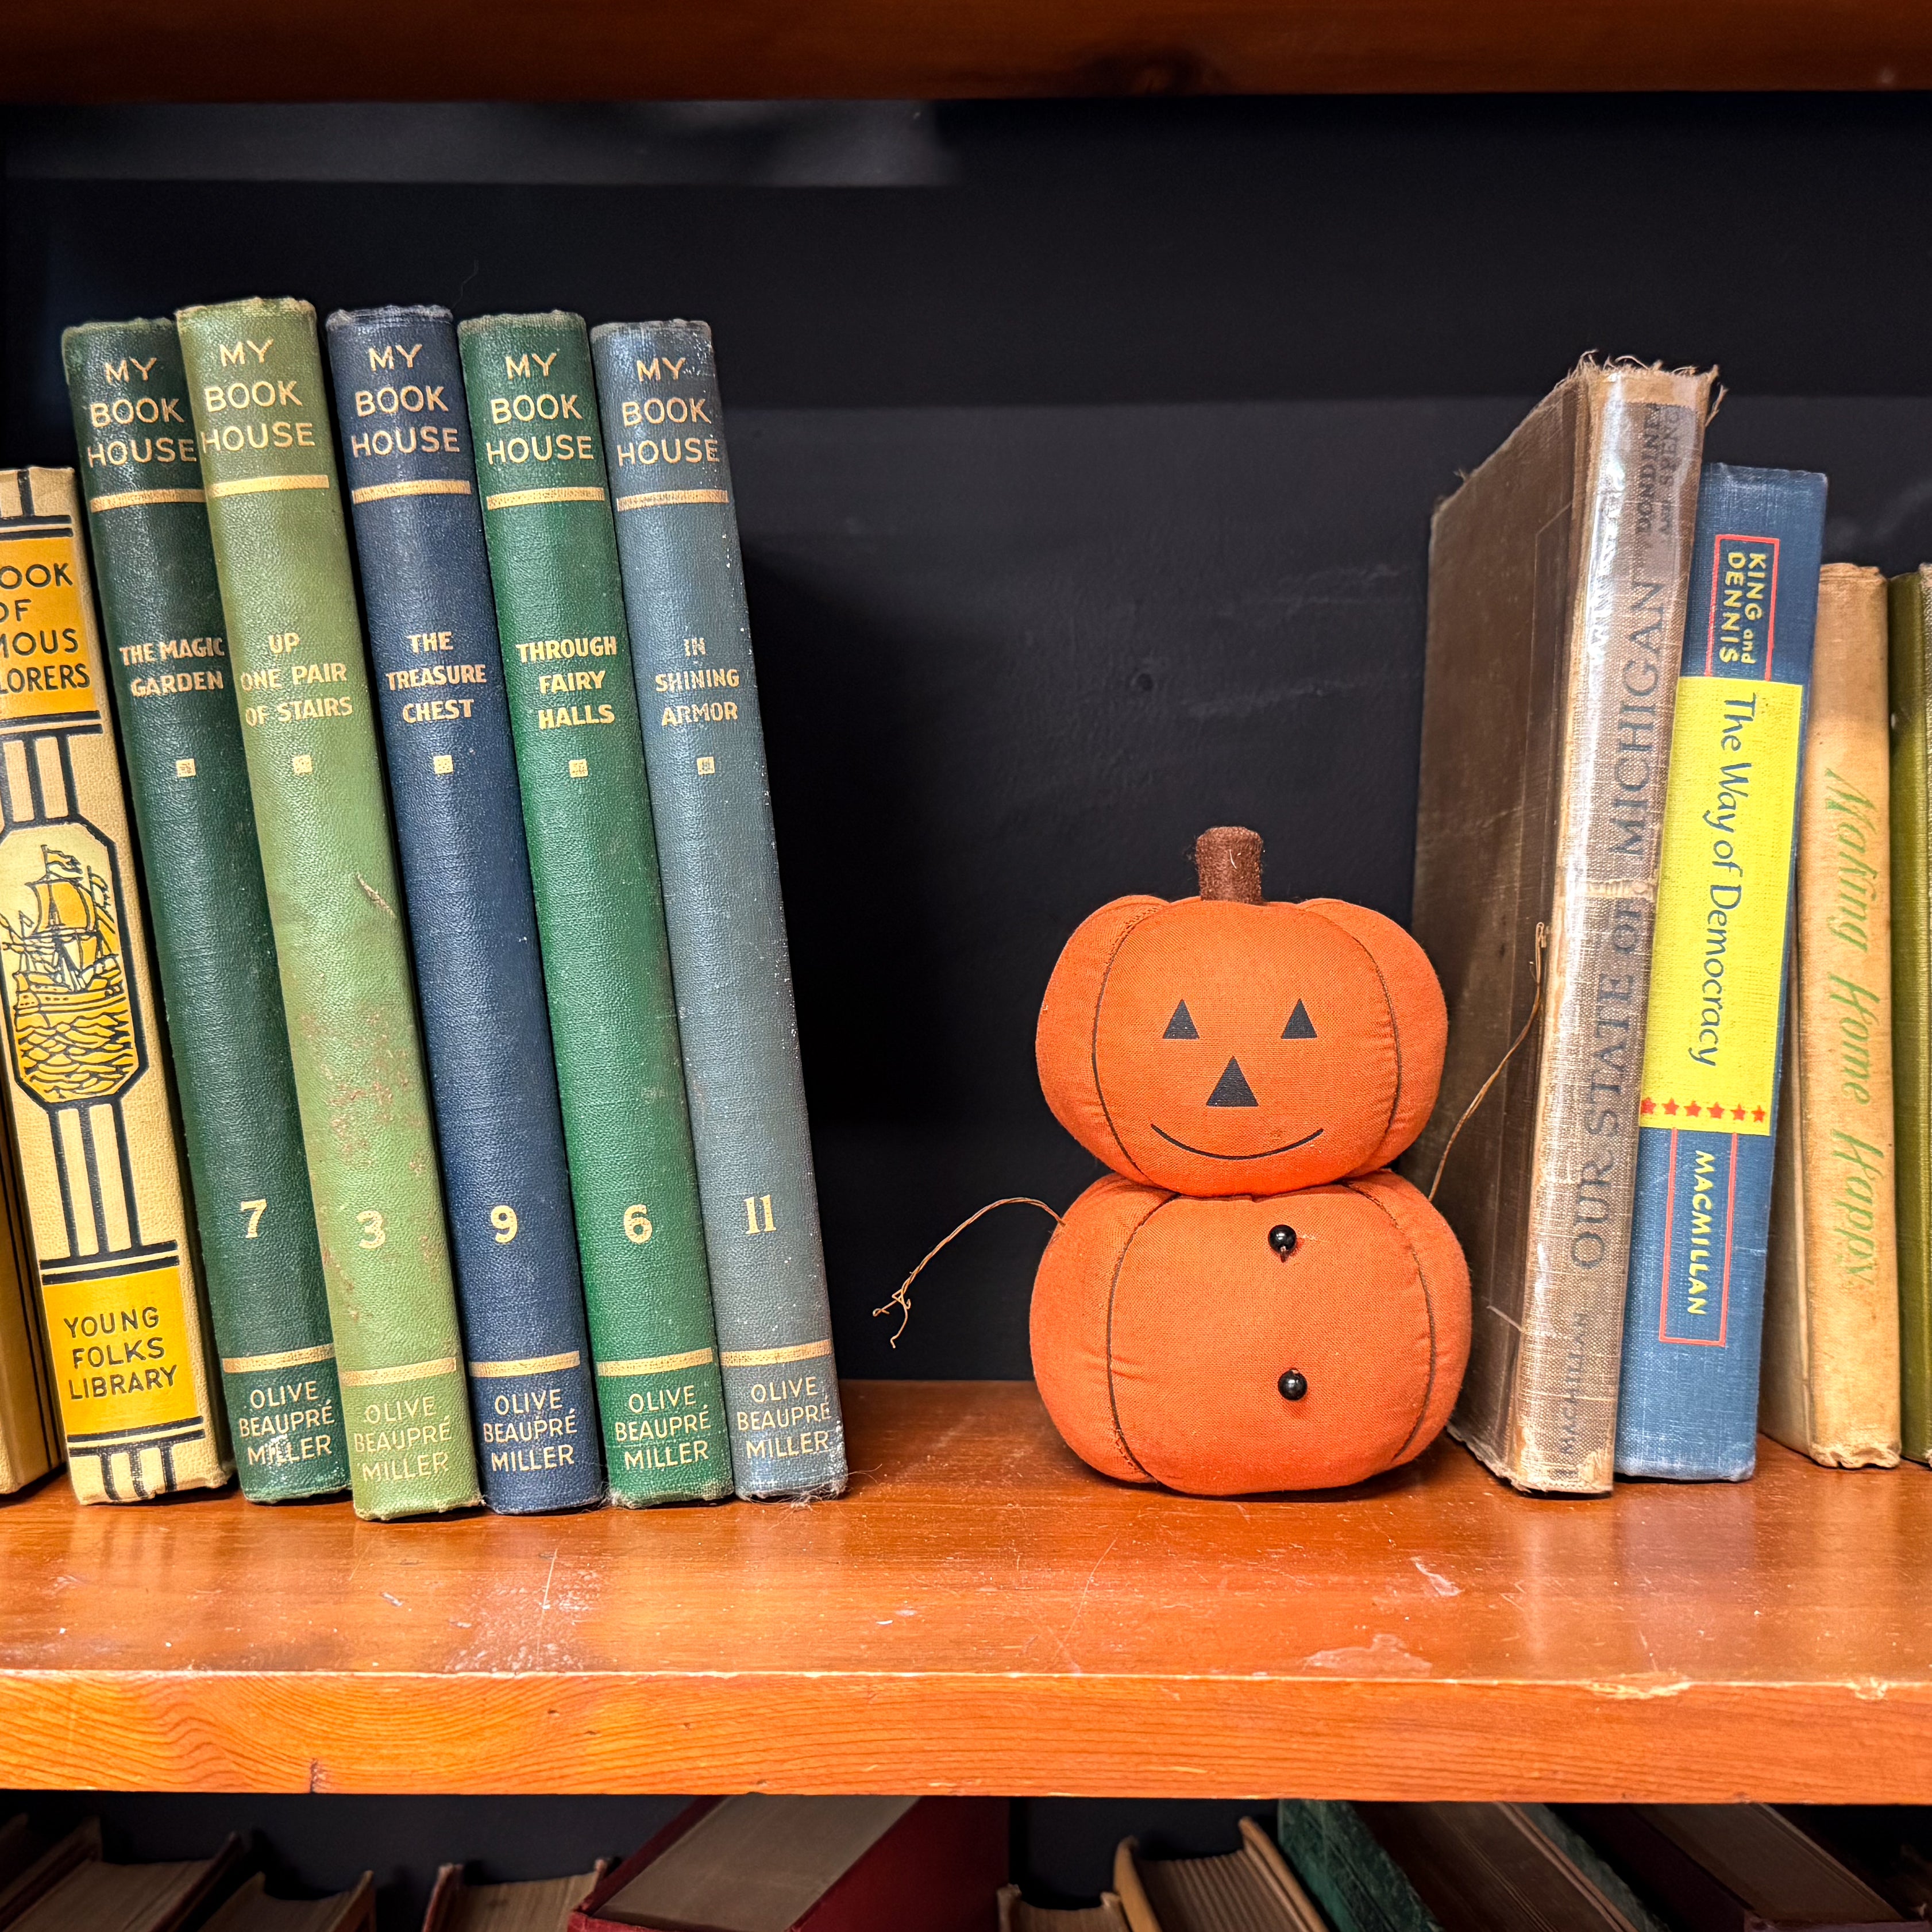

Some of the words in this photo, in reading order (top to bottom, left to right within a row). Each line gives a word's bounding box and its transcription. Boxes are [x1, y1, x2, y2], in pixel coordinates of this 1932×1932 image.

[219, 338, 274, 367] MY
[368, 344, 423, 371] MY
[505, 352, 560, 380] MY
[105, 357, 157, 383] MY
[636, 357, 686, 383] MY
[204, 380, 303, 413] BOOK
[354, 385, 449, 417] BOOK
[490, 394, 584, 424] BOOK
[90, 398, 184, 428] BOOK
[622, 398, 711, 427] BOOK
[87, 438, 197, 468] HOUSE
[202, 422, 315, 453] HOUSE
[351, 426, 460, 458] HOUSE
[486, 434, 594, 465] HOUSE
[618, 438, 720, 466] HOUSE
[1744, 551, 1768, 621] KING
[1719, 551, 1746, 664] DENNIS
[119, 646, 157, 666] THE
[159, 637, 225, 660] MAGIC
[268, 633, 300, 655] UP
[408, 631, 454, 654] THE
[516, 636, 618, 663] THROUGH
[684, 638, 706, 657] IN
[1741, 631, 1757, 665] and
[130, 670, 224, 697] GARDEN
[241, 668, 283, 691] ONE
[291, 662, 348, 685] PAIR
[385, 664, 487, 691] TREASURE
[539, 670, 606, 694] FAIRY
[655, 669, 740, 692] SHINING
[245, 706, 269, 727] OF
[278, 697, 353, 723] STAIRS
[402, 699, 475, 724] CHEST
[538, 704, 615, 730] HALLS
[662, 701, 738, 727] ARMOR
[1609, 581, 1664, 856] MICHIGAN
[1720, 691, 1757, 753] The
[1702, 762, 1752, 834] Way
[1712, 838, 1743, 877] of
[1824, 768, 1878, 954] Making
[1688, 883, 1743, 1067] Democracy
[1829, 973, 1881, 1105] Home
[1584, 977, 1632, 1135] STATE
[241, 1198, 267, 1238] 7
[745, 1194, 777, 1235] 11
[1570, 1149, 1613, 1270] OUR
[1831, 1129, 1883, 1287] Happy
[356, 1210, 387, 1249] 3
[490, 1205, 518, 1244] 9
[623, 1204, 653, 1244] 6
[1686, 1150, 1715, 1316] MACMILLAN
[64, 1306, 159, 1339] YOUNG
[72, 1336, 165, 1369] FOLKS
[68, 1365, 178, 1401] LIBRARY
[250, 1380, 319, 1410] OLIVE
[751, 1376, 817, 1403] OLIVE
[365, 1396, 435, 1424] OLIVE
[495, 1388, 562, 1417] OLIVE
[628, 1385, 697, 1414] OLIVE
[736, 1394, 832, 1432] BEAUPRÉ
[238, 1398, 336, 1438] BEAUPRÉ
[353, 1415, 452, 1452] BEAUPRÉ
[483, 1407, 577, 1444] BEAUPRÉ
[615, 1403, 711, 1443] BEAUPRÉ
[248, 1434, 331, 1467] MILLER
[491, 1444, 574, 1472] MILLER
[624, 1440, 709, 1471] MILLER
[746, 1430, 829, 1459] MILLER
[363, 1451, 449, 1482] MILLER
